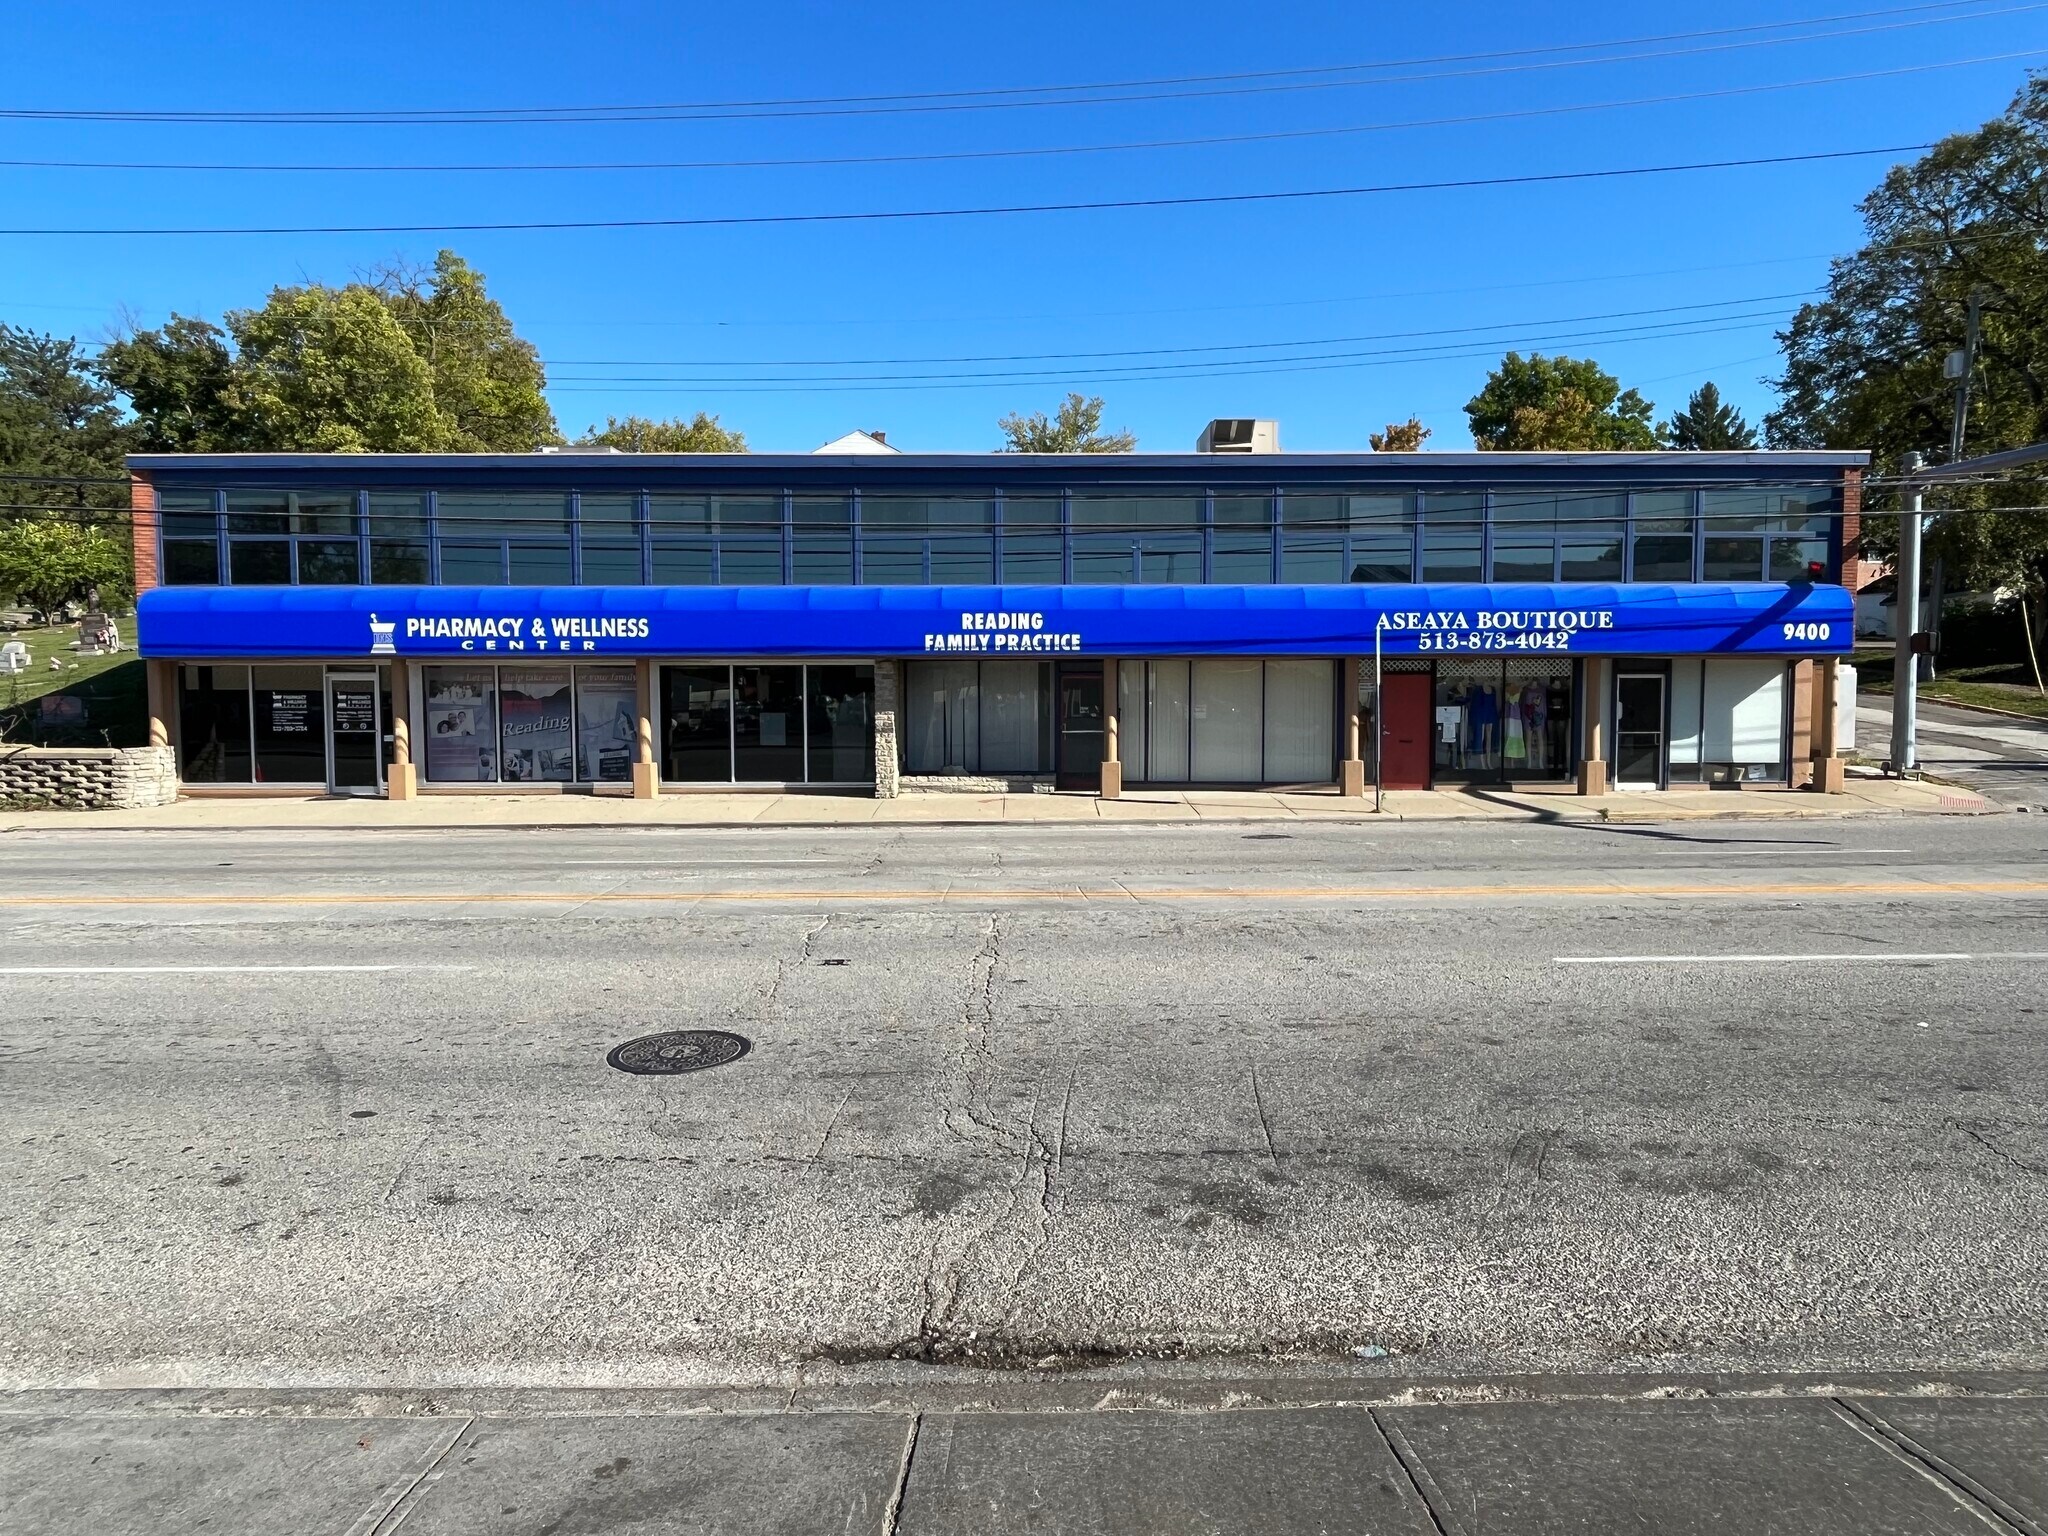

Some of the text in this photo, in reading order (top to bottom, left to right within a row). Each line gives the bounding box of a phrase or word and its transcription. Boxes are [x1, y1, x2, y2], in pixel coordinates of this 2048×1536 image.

[407, 618, 649, 637] PHARMACY & WELLNESS
[962, 613, 1043, 630] READING
[1377, 612, 1613, 634] ASEAYA BOUTIQUE
[1784, 623, 1830, 640] 9400
[461, 640, 595, 650] CENTER
[925, 634, 1081, 650] FAMILY PRACTICE
[1419, 632, 1568, 650] 513-873-4042
[505, 673, 523, 683] help
[503, 715, 571, 737] Reading
